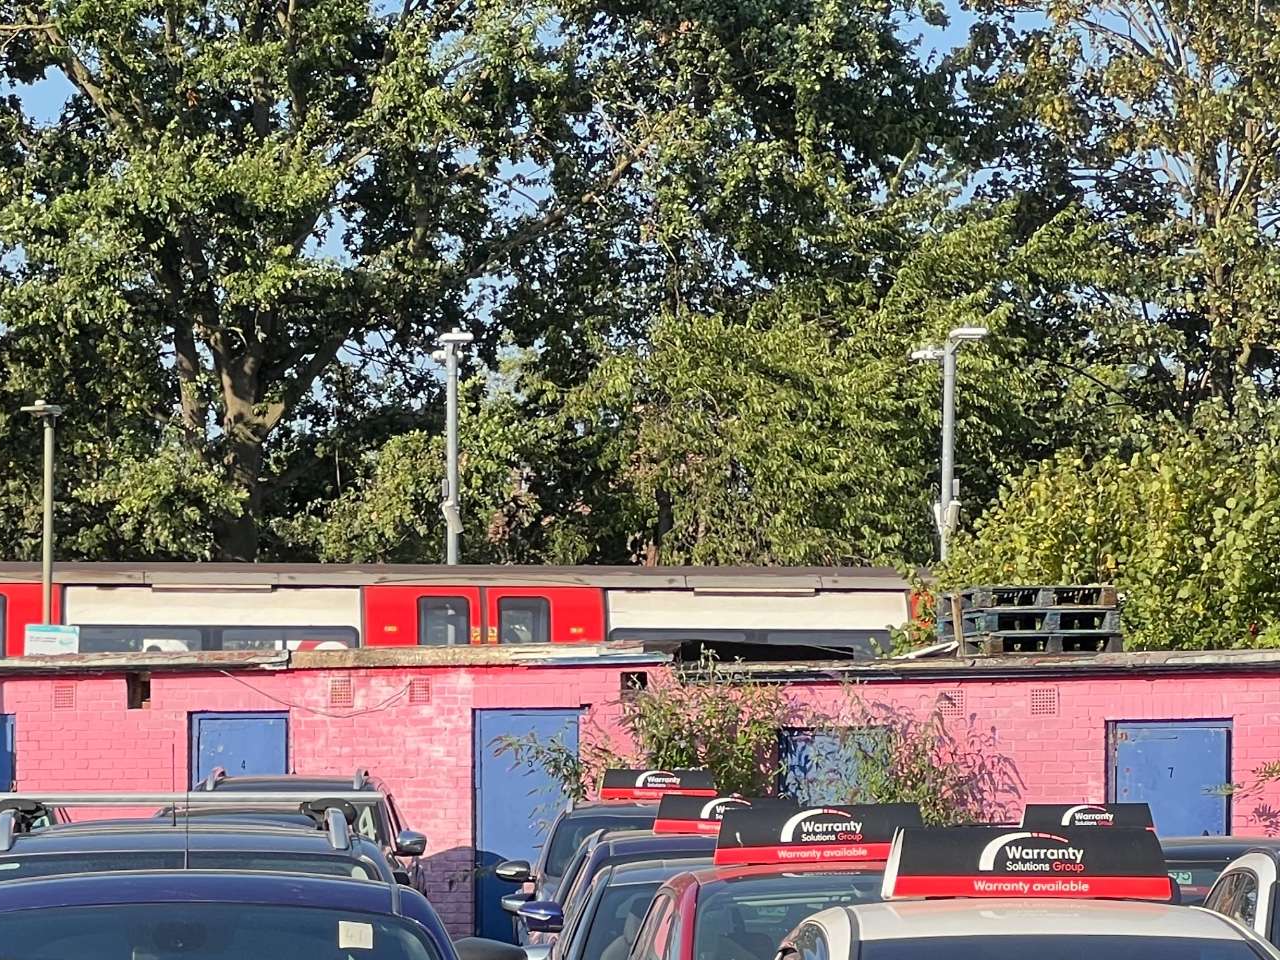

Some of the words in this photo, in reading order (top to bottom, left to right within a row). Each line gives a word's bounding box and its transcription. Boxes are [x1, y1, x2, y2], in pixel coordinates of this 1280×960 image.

[1167, 766, 1174, 778] 7
[646, 776, 681, 785] Warranty
[1074, 811, 1114, 822] Warranty
[801, 820, 863, 834] Warranty
[801, 833, 836, 842] Solutions
[837, 832, 863, 842] Group
[777, 848, 821, 859] Warranty
[823, 847, 868, 858] available
[1005, 845, 1084, 863] Warranty
[1006, 861, 1050, 871] Solutions
[1052, 861, 1085, 873] Group
[973, 880, 1029, 893] Warranty
[1032, 879, 1089, 892] available
